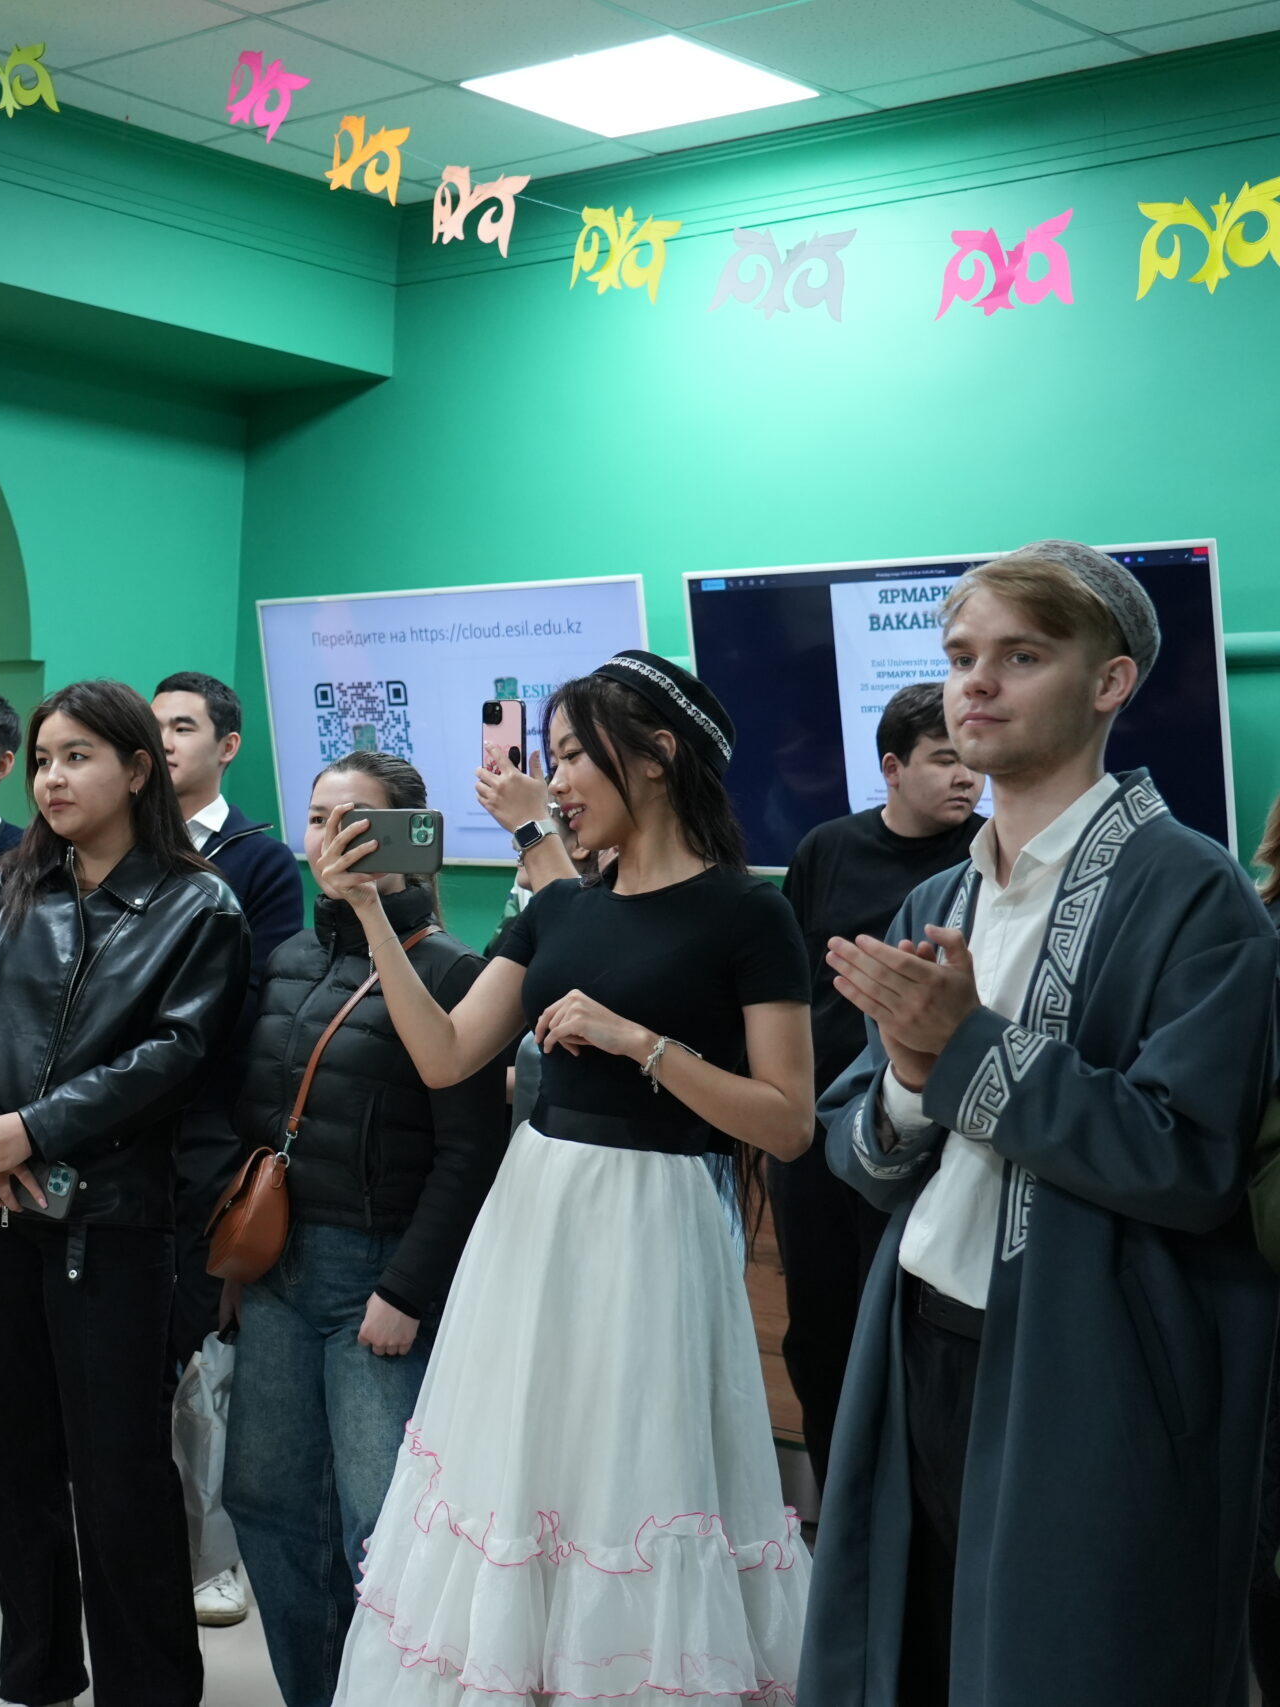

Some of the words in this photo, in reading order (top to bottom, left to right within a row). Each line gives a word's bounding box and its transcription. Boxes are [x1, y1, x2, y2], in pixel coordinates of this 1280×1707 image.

[311, 630, 386, 650] Перейдите
[389, 631, 406, 643] на
[409, 617, 583, 645] https://cloud.esil.edu.kz
[871, 659, 886, 668] Esil
[887, 658, 928, 668] University
[876, 670, 917, 679] ЯРМАРКУ
[860, 683, 869, 692] 25
[870, 684, 900, 693] апреля
